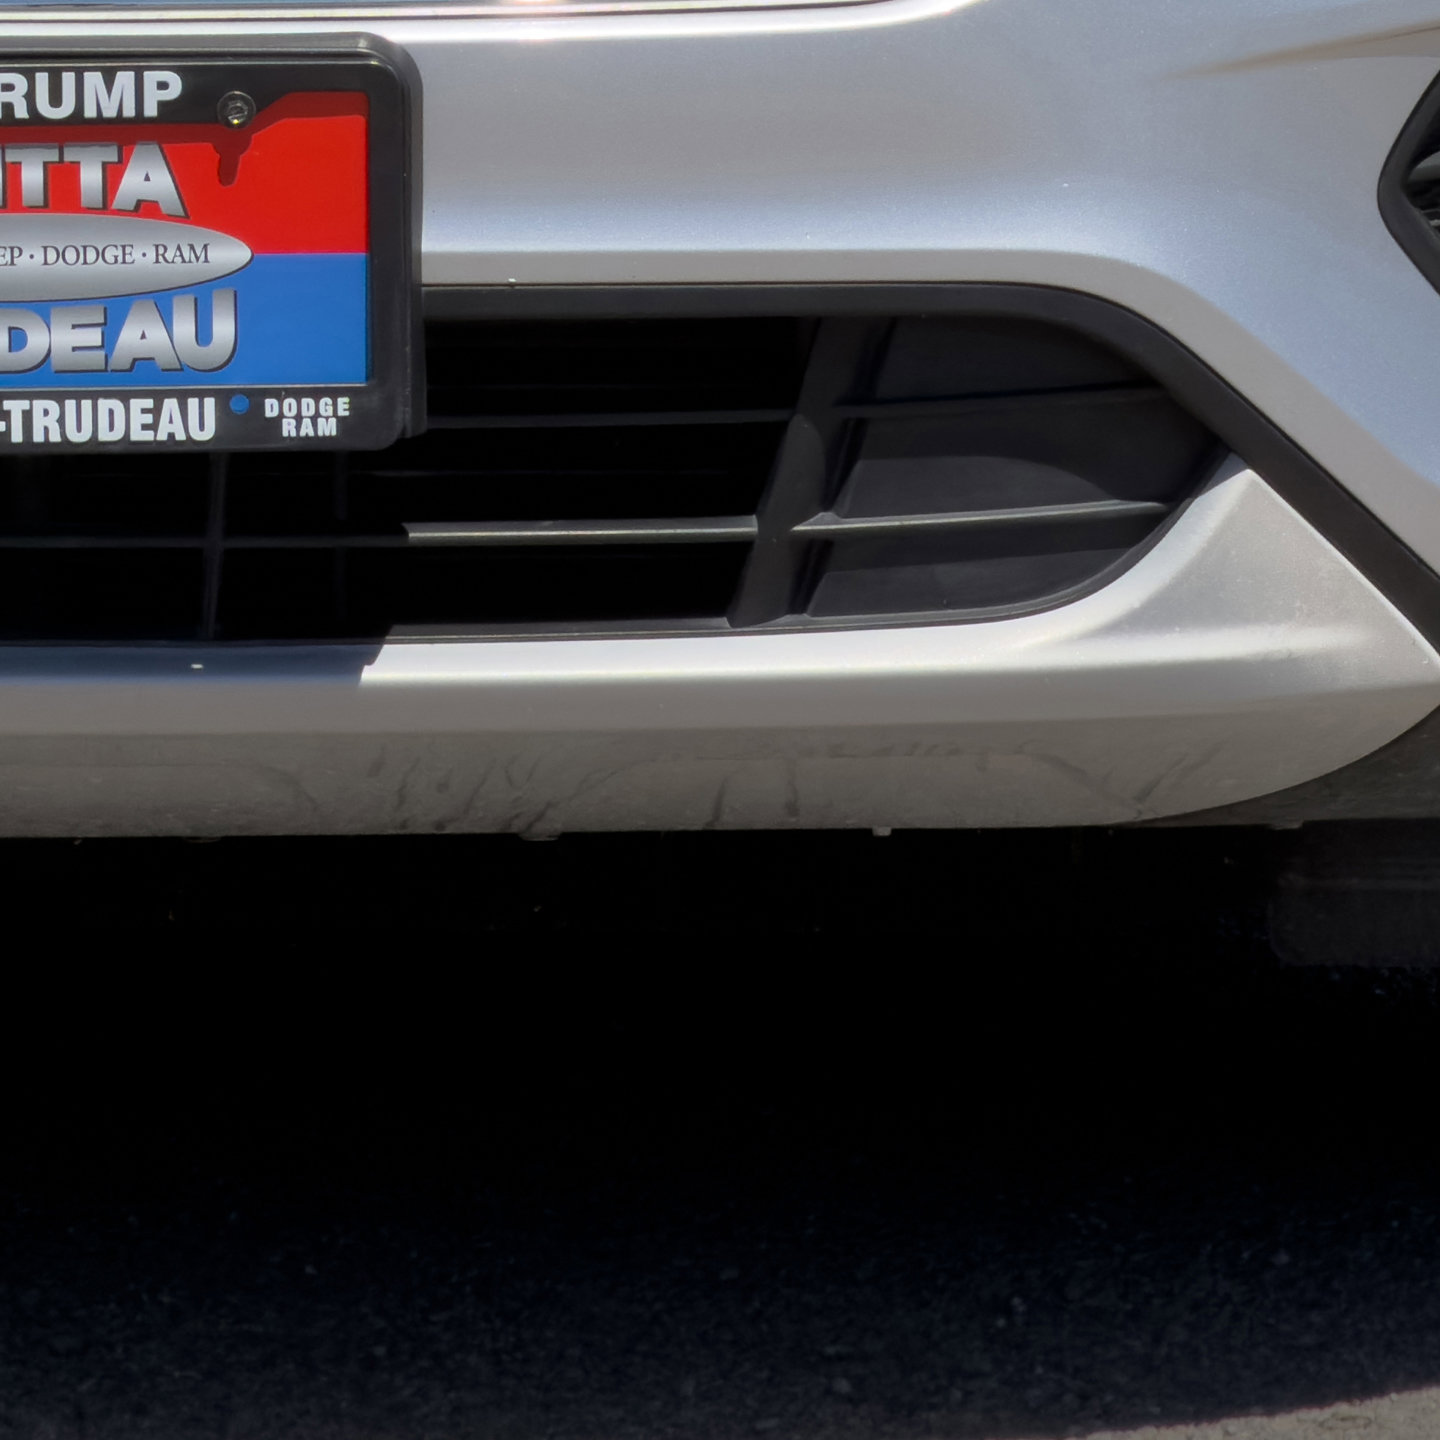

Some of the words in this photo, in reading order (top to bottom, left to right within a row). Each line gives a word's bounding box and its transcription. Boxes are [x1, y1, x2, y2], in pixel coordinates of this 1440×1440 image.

[41, 244, 136, 267] DODGE
[153, 243, 211, 265] RAM
[264, 397, 350, 417] DODGE
[282, 417, 337, 437] RAM
